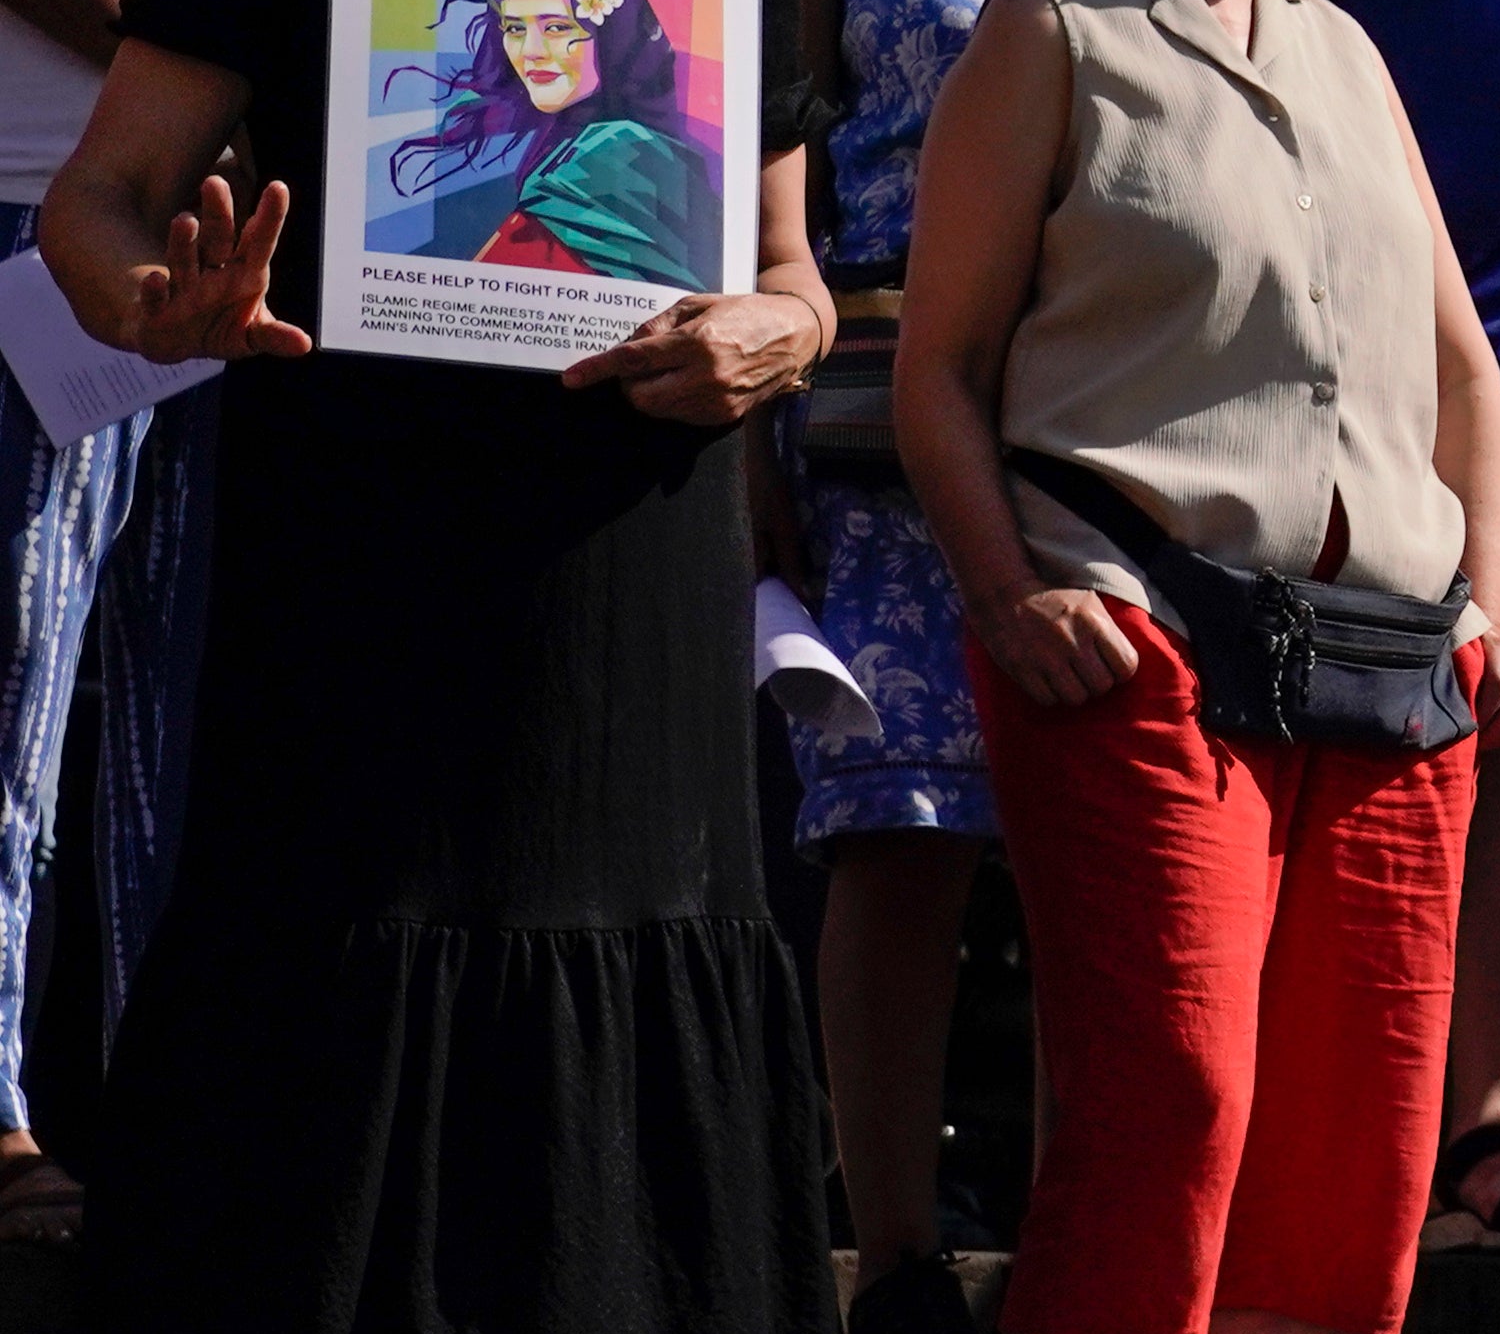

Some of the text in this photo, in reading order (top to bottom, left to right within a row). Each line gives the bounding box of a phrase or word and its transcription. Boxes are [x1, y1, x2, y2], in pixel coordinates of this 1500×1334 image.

[362, 267, 658, 311] PLEASE HELP TO FIGHT FOR JUSTICE
[361, 307, 433, 323] PLANNING
[437, 312, 456, 325] TO
[460, 316, 569, 337] COMMEMORATE
[574, 327, 621, 343] MAHSA
[362, 293, 641, 332] ISLAMIC REGIME ARRESTS ANY ACTIVIST
[360, 320, 408, 334] AMIN'S
[411, 324, 511, 344] ANNIVERSARY
[514, 334, 571, 349] ACROSS
[575, 339, 607, 352] IRAN
